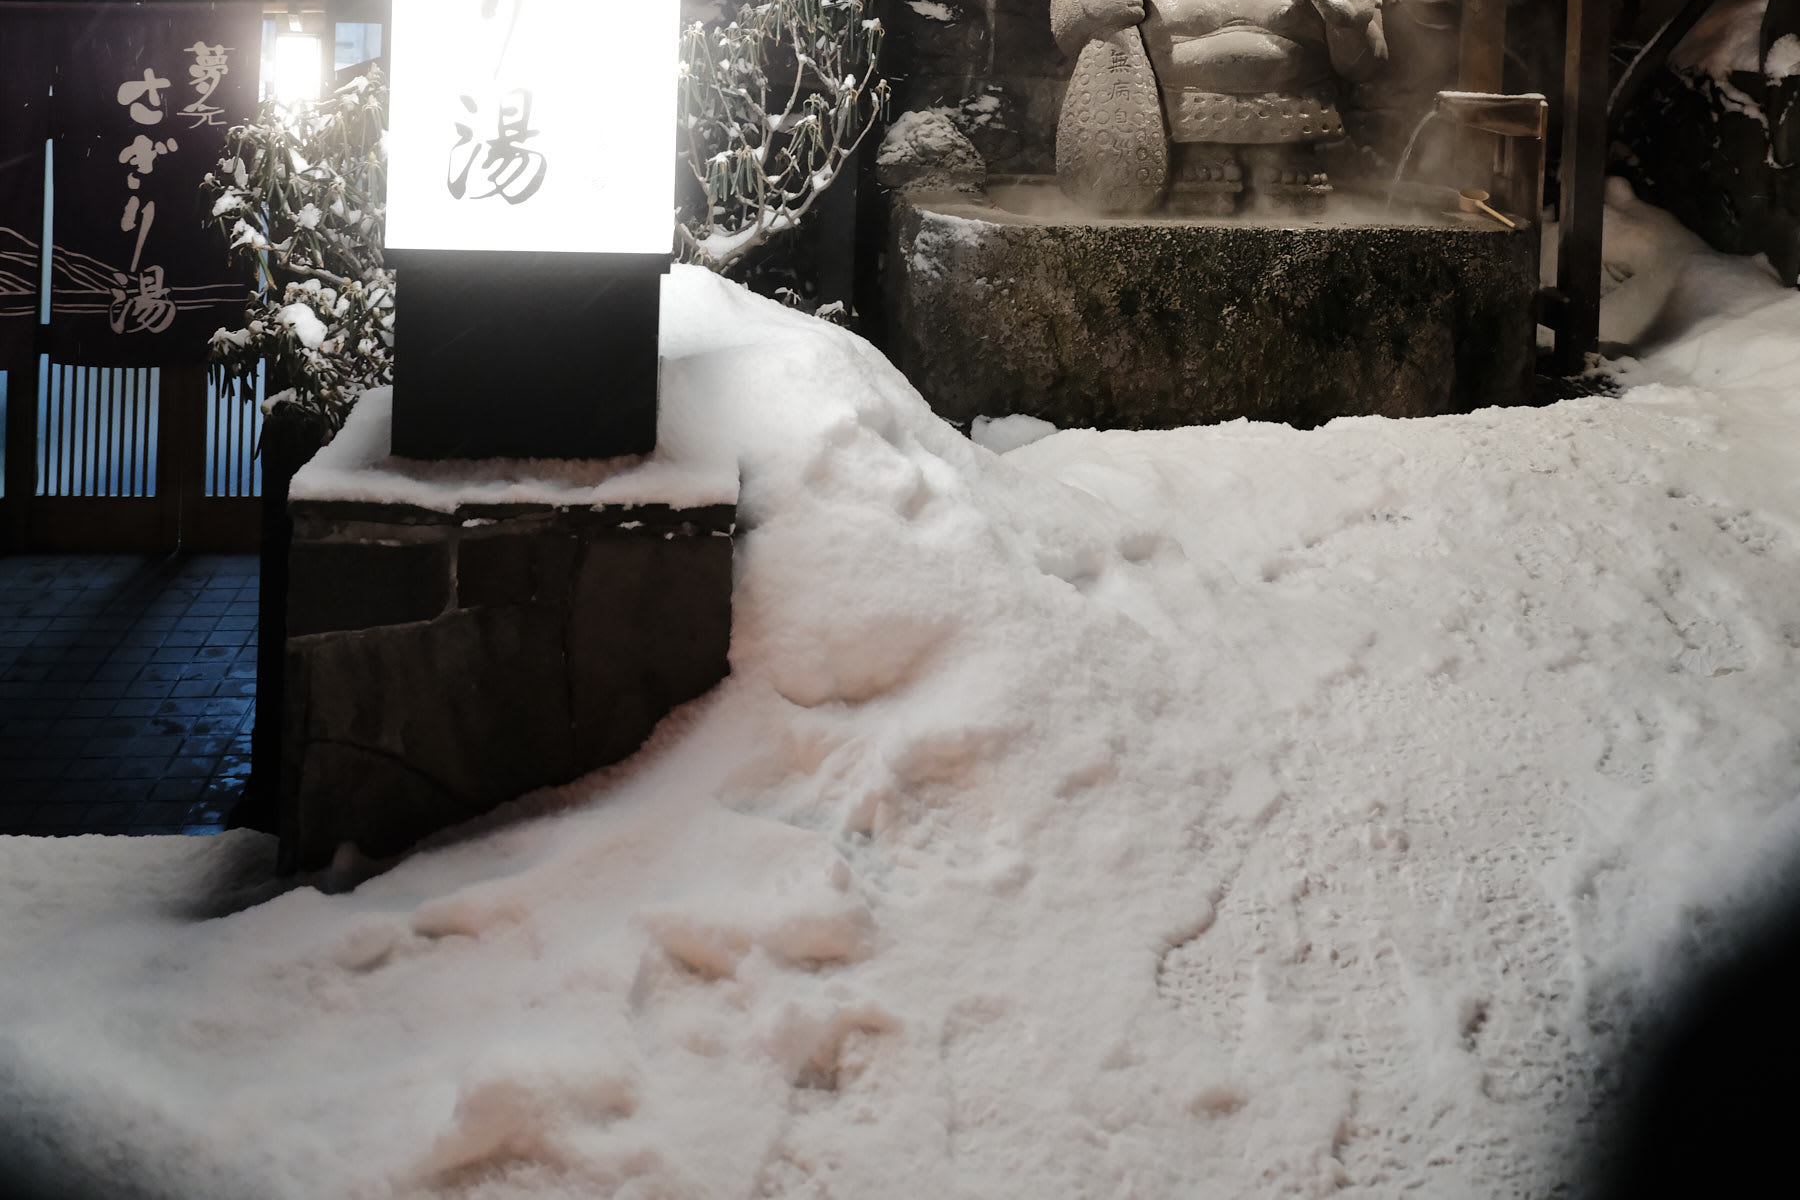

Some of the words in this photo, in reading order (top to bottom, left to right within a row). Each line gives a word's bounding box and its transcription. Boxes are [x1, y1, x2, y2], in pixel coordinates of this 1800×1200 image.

[177, 41, 235, 128] 夢元
[109, 67, 178, 335] さぎり湯
